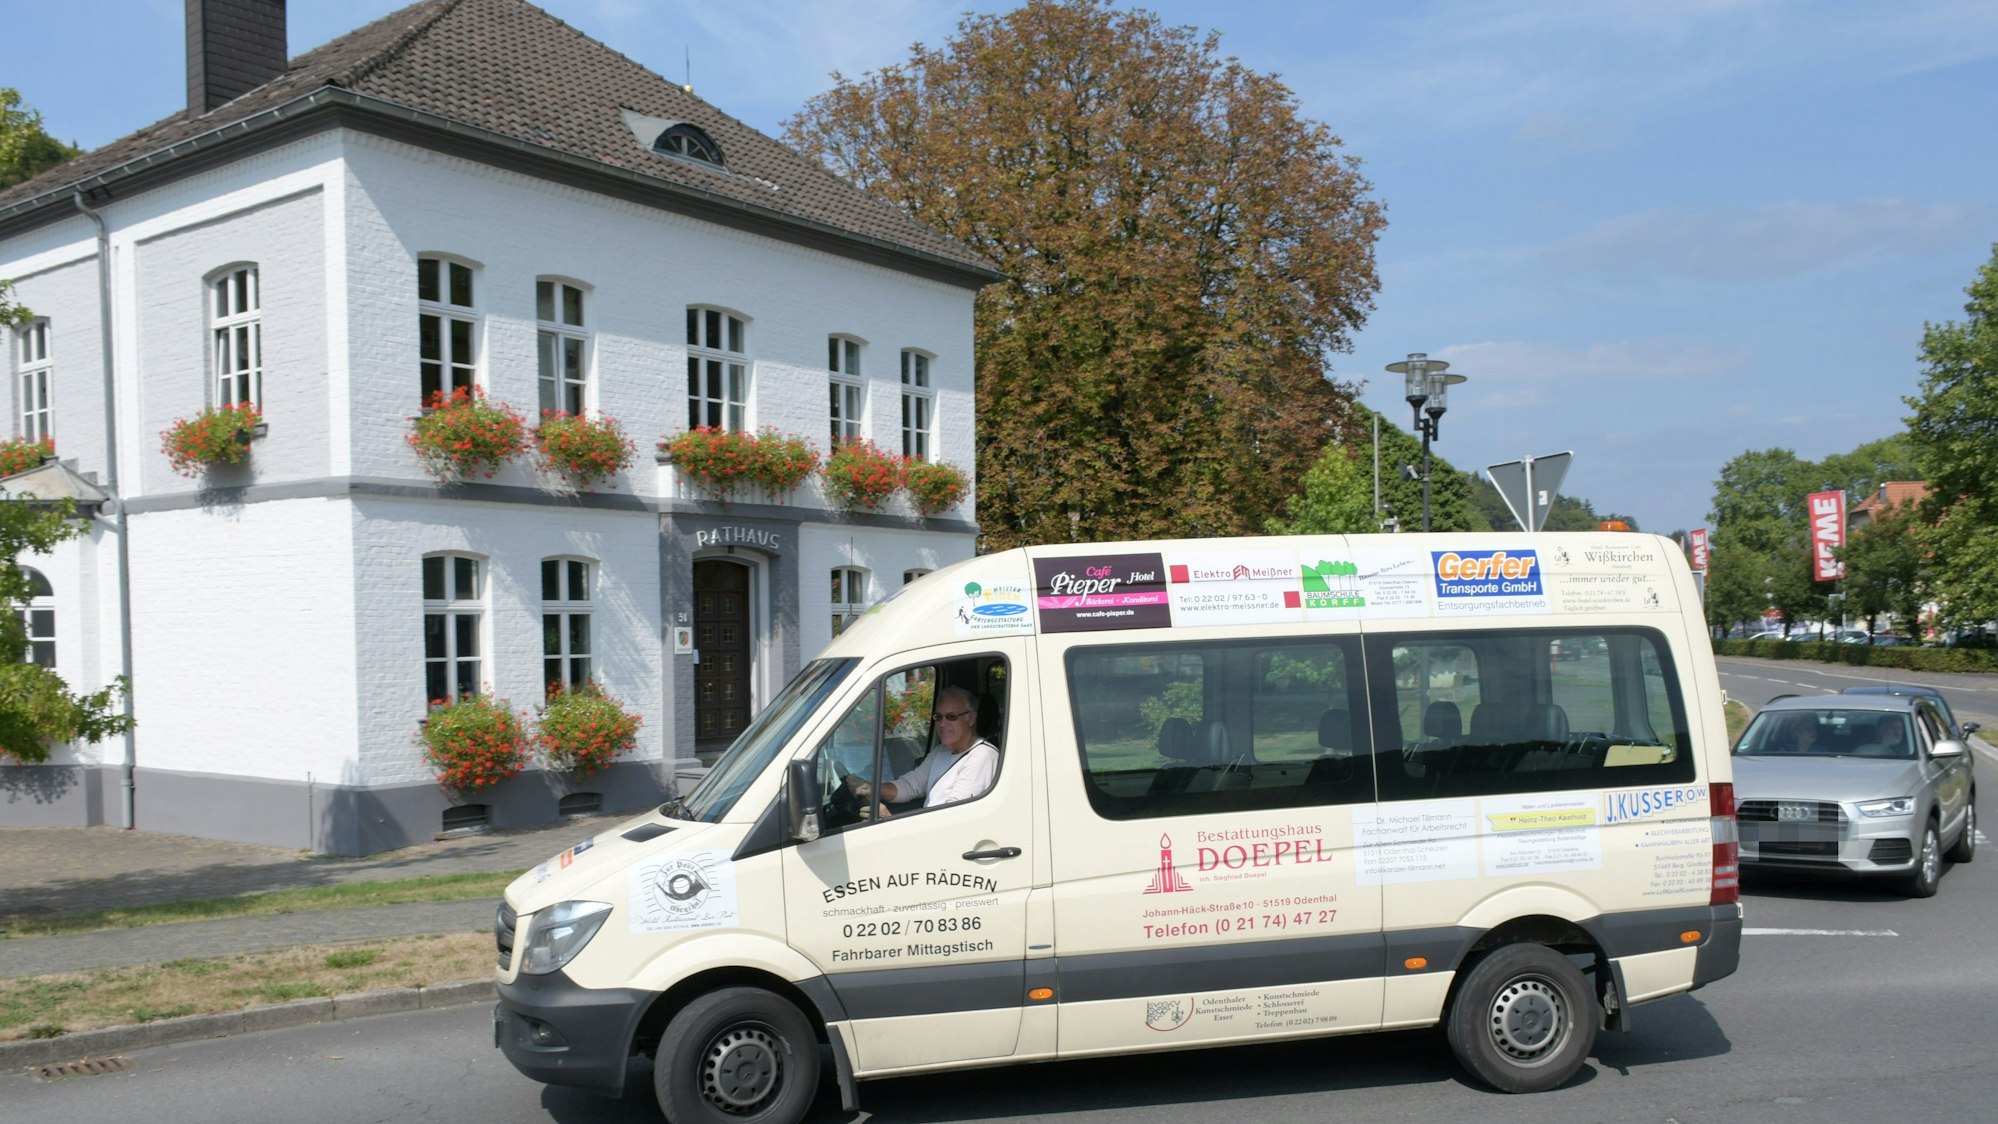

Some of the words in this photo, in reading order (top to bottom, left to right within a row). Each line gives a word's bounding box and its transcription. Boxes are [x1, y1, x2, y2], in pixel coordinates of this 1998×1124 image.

[696, 526, 781, 549] RATHAUS
[1584, 550, 1654, 565] Wißkirchen
[1086, 566, 1112, 579] Café
[1438, 552, 1536, 581] Gerfer
[1193, 570, 1231, 579] Elektro
[1252, 568, 1293, 578] Meißner
[1600, 574, 1630, 583] wieder
[1050, 571, 1122, 606] Pieper
[1127, 571, 1154, 584] Hotel
[1440, 583, 1498, 595] Transporte
[1502, 582, 1537, 593] GmbH
[1122, 596, 1158, 604] Konditorei
[1310, 598, 1360, 606] KORFF
[1438, 600, 1546, 612] Entsorgungsfachbetrieb
[1076, 609, 1134, 618] www.cafe-pieper.de
[1180, 602, 1279, 612] www.elektro-meissner.de
[1390, 816, 1420, 824] Michael
[1422, 814, 1452, 822] Tillmann
[1197, 824, 1322, 842] Bestattungshaus
[1362, 826, 1408, 836] Fachanwalt
[1410, 825, 1419, 833] für
[1422, 823, 1467, 832] Arbeitsrecht
[1197, 839, 1334, 872] DOEPEL
[822, 876, 881, 904] ESSEN
[886, 872, 920, 888] AUF
[926, 869, 998, 893] RÄDERN
[822, 904, 885, 918] schmackhaft
[893, 901, 947, 913] zuverlässig
[955, 897, 999, 910] preiswert
[1142, 902, 1242, 918] Johann-Häck-Straße
[1243, 901, 1254, 909] 10
[1263, 898, 1291, 908] 51519
[1293, 894, 1337, 905] Odenthal
[843, 924, 853, 938] 0
[857, 922, 877, 937] 22
[881, 921, 901, 936] 02
[914, 919, 934, 934] 70
[938, 918, 958, 932] 83
[962, 916, 982, 930] 86
[1143, 922, 1208, 938] Telefon
[1216, 918, 1230, 935] (0
[1236, 917, 1254, 930] 21
[1262, 914, 1286, 930] 74)
[1294, 912, 1312, 925] 47
[1318, 910, 1337, 923] 27
[832, 947, 903, 962] Fahrbarer
[907, 939, 993, 956] Mittagstisch
[1202, 996, 1246, 1006] Odenthaler
[1263, 990, 1320, 1001] Kunstschmiede
[1195, 1004, 1253, 1015] Kunstschmiede
[1263, 1000, 1304, 1009] Schlosserei
[1263, 1008, 1308, 1018] Treppenbau
[1254, 1021, 1283, 1029] Telefon
